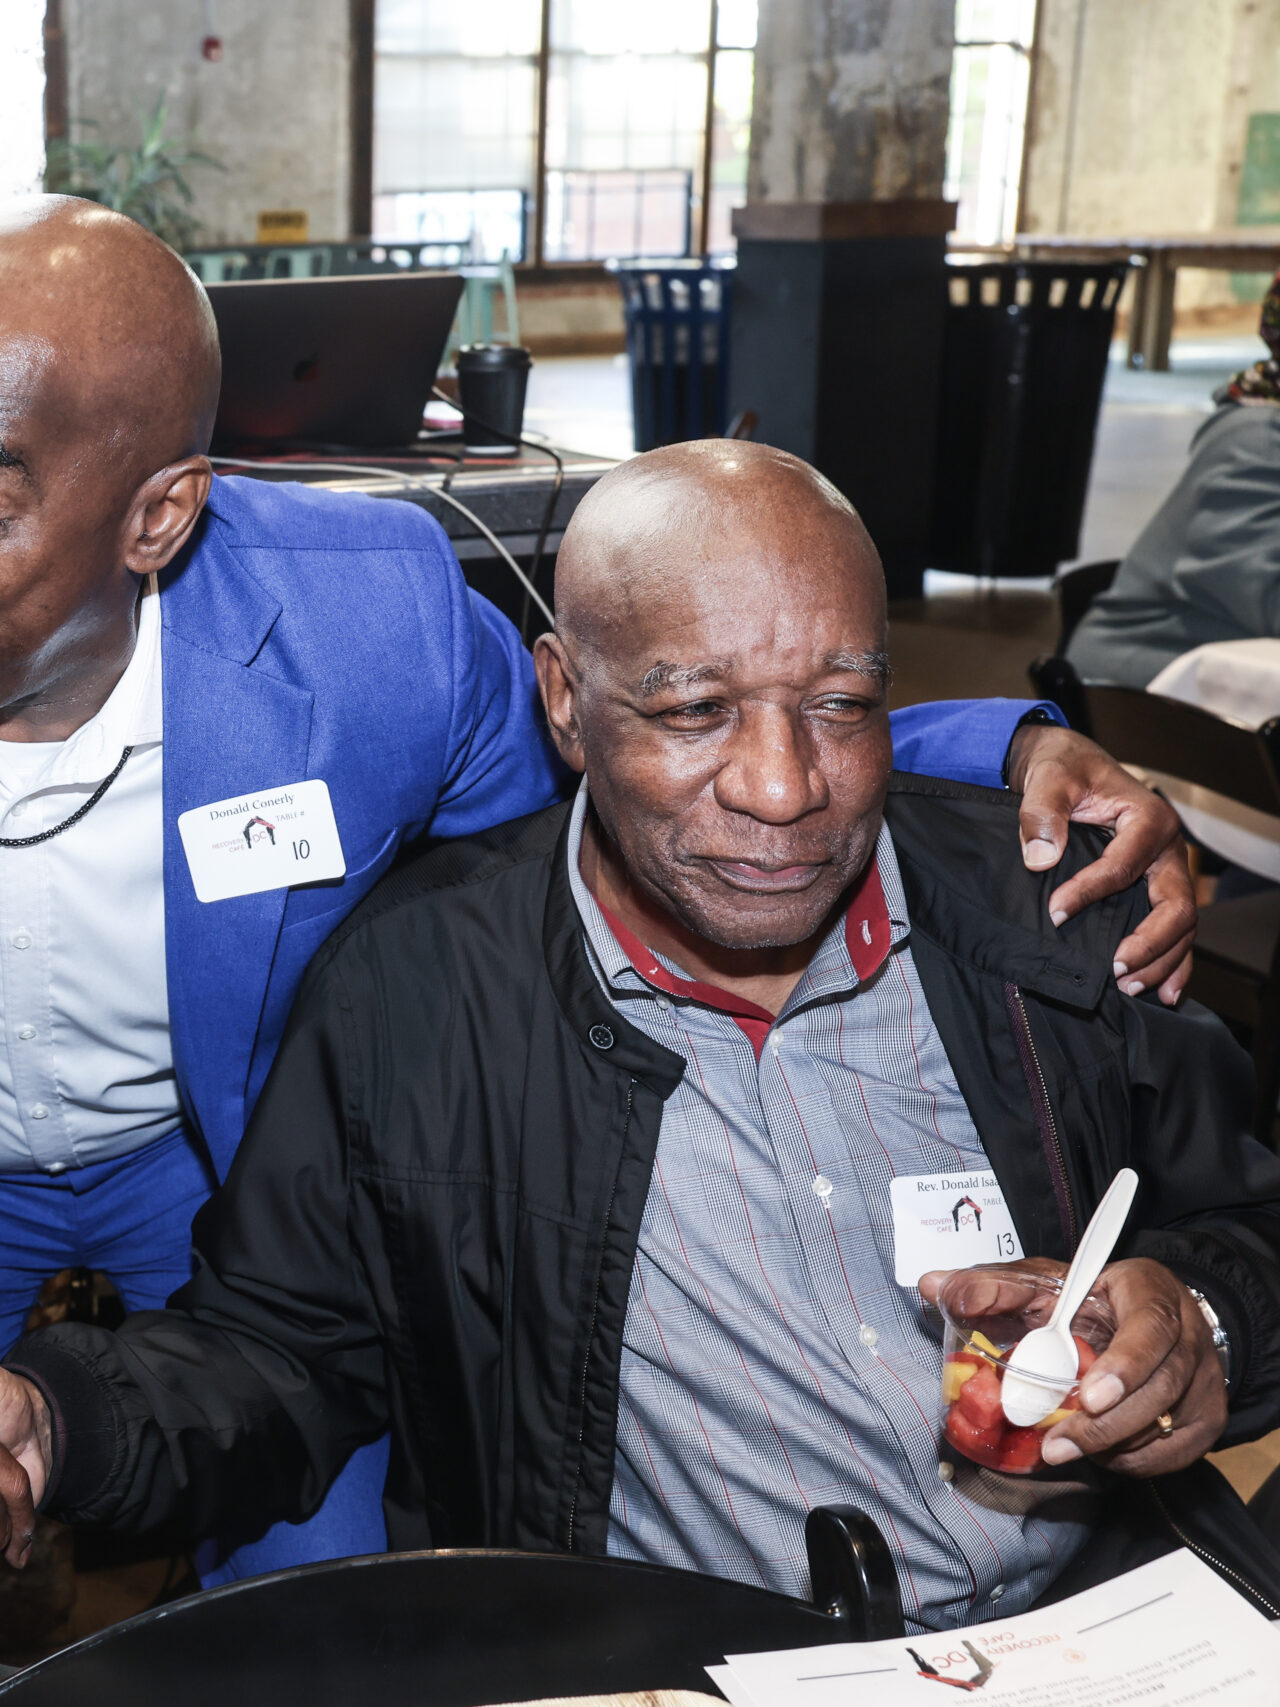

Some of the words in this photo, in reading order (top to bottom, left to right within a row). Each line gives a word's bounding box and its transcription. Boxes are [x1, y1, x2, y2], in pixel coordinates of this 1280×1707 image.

[210, 802, 249, 820] Donald
[252, 793, 294, 810] Conerly
[276, 811, 298, 822] TABLE
[212, 838, 244, 849] RECOVERY
[252, 831, 267, 843] DC
[292, 839, 310, 860] 10
[917, 1181, 938, 1192] Rev.
[941, 1177, 979, 1191] Donald
[983, 1197, 1002, 1206] TABLE
[920, 1217, 952, 1226] RECOVERY
[960, 1213, 975, 1226] DC
[997, 1233, 1015, 1256] 13
[987, 1632, 1061, 1656] RECOVERY
[932, 1650, 967, 1669] DC
